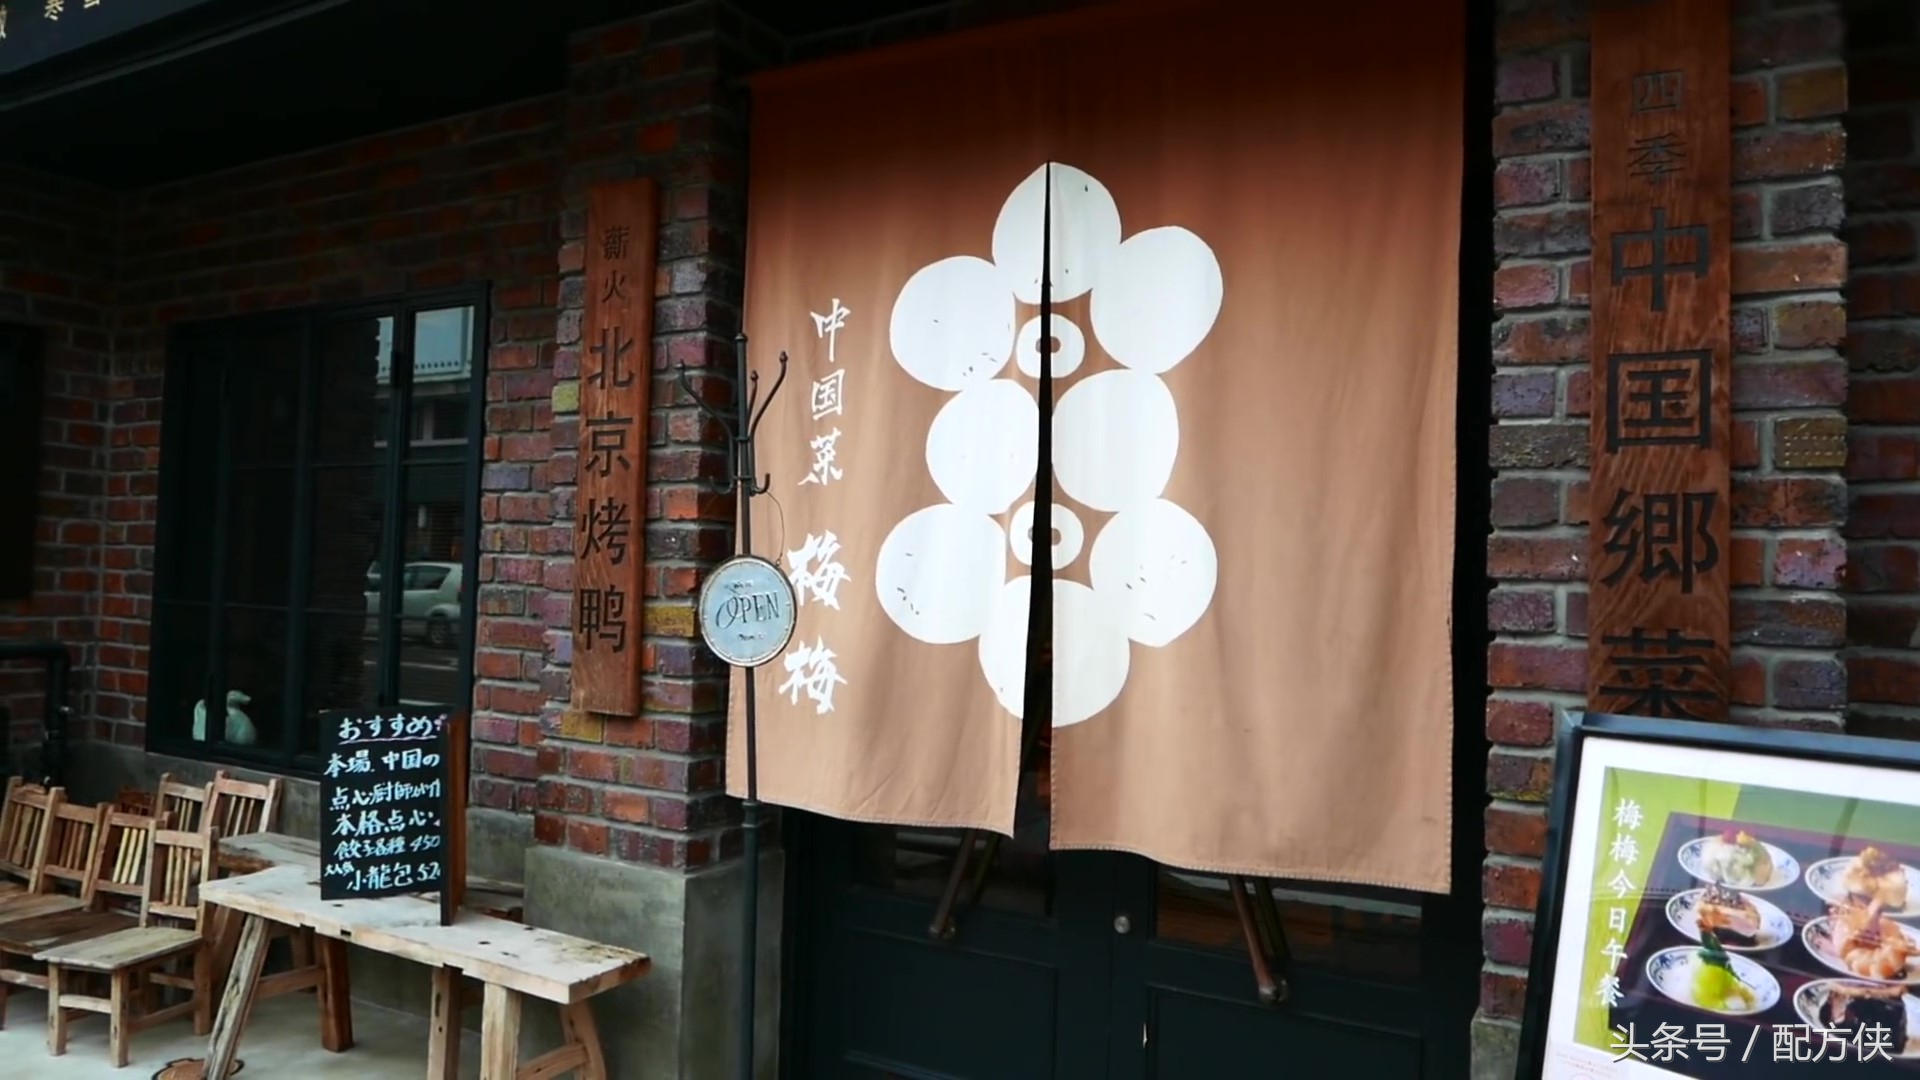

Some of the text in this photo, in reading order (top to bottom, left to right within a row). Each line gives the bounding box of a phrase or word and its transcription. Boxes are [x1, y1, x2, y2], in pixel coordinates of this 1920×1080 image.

[778, 298, 852, 715] 中国菜 梅梅
[715, 590, 779, 629] OPEN
[409, 834, 440, 852] 450
[1596, 798, 1643, 1007] 梅梅今日午餐
